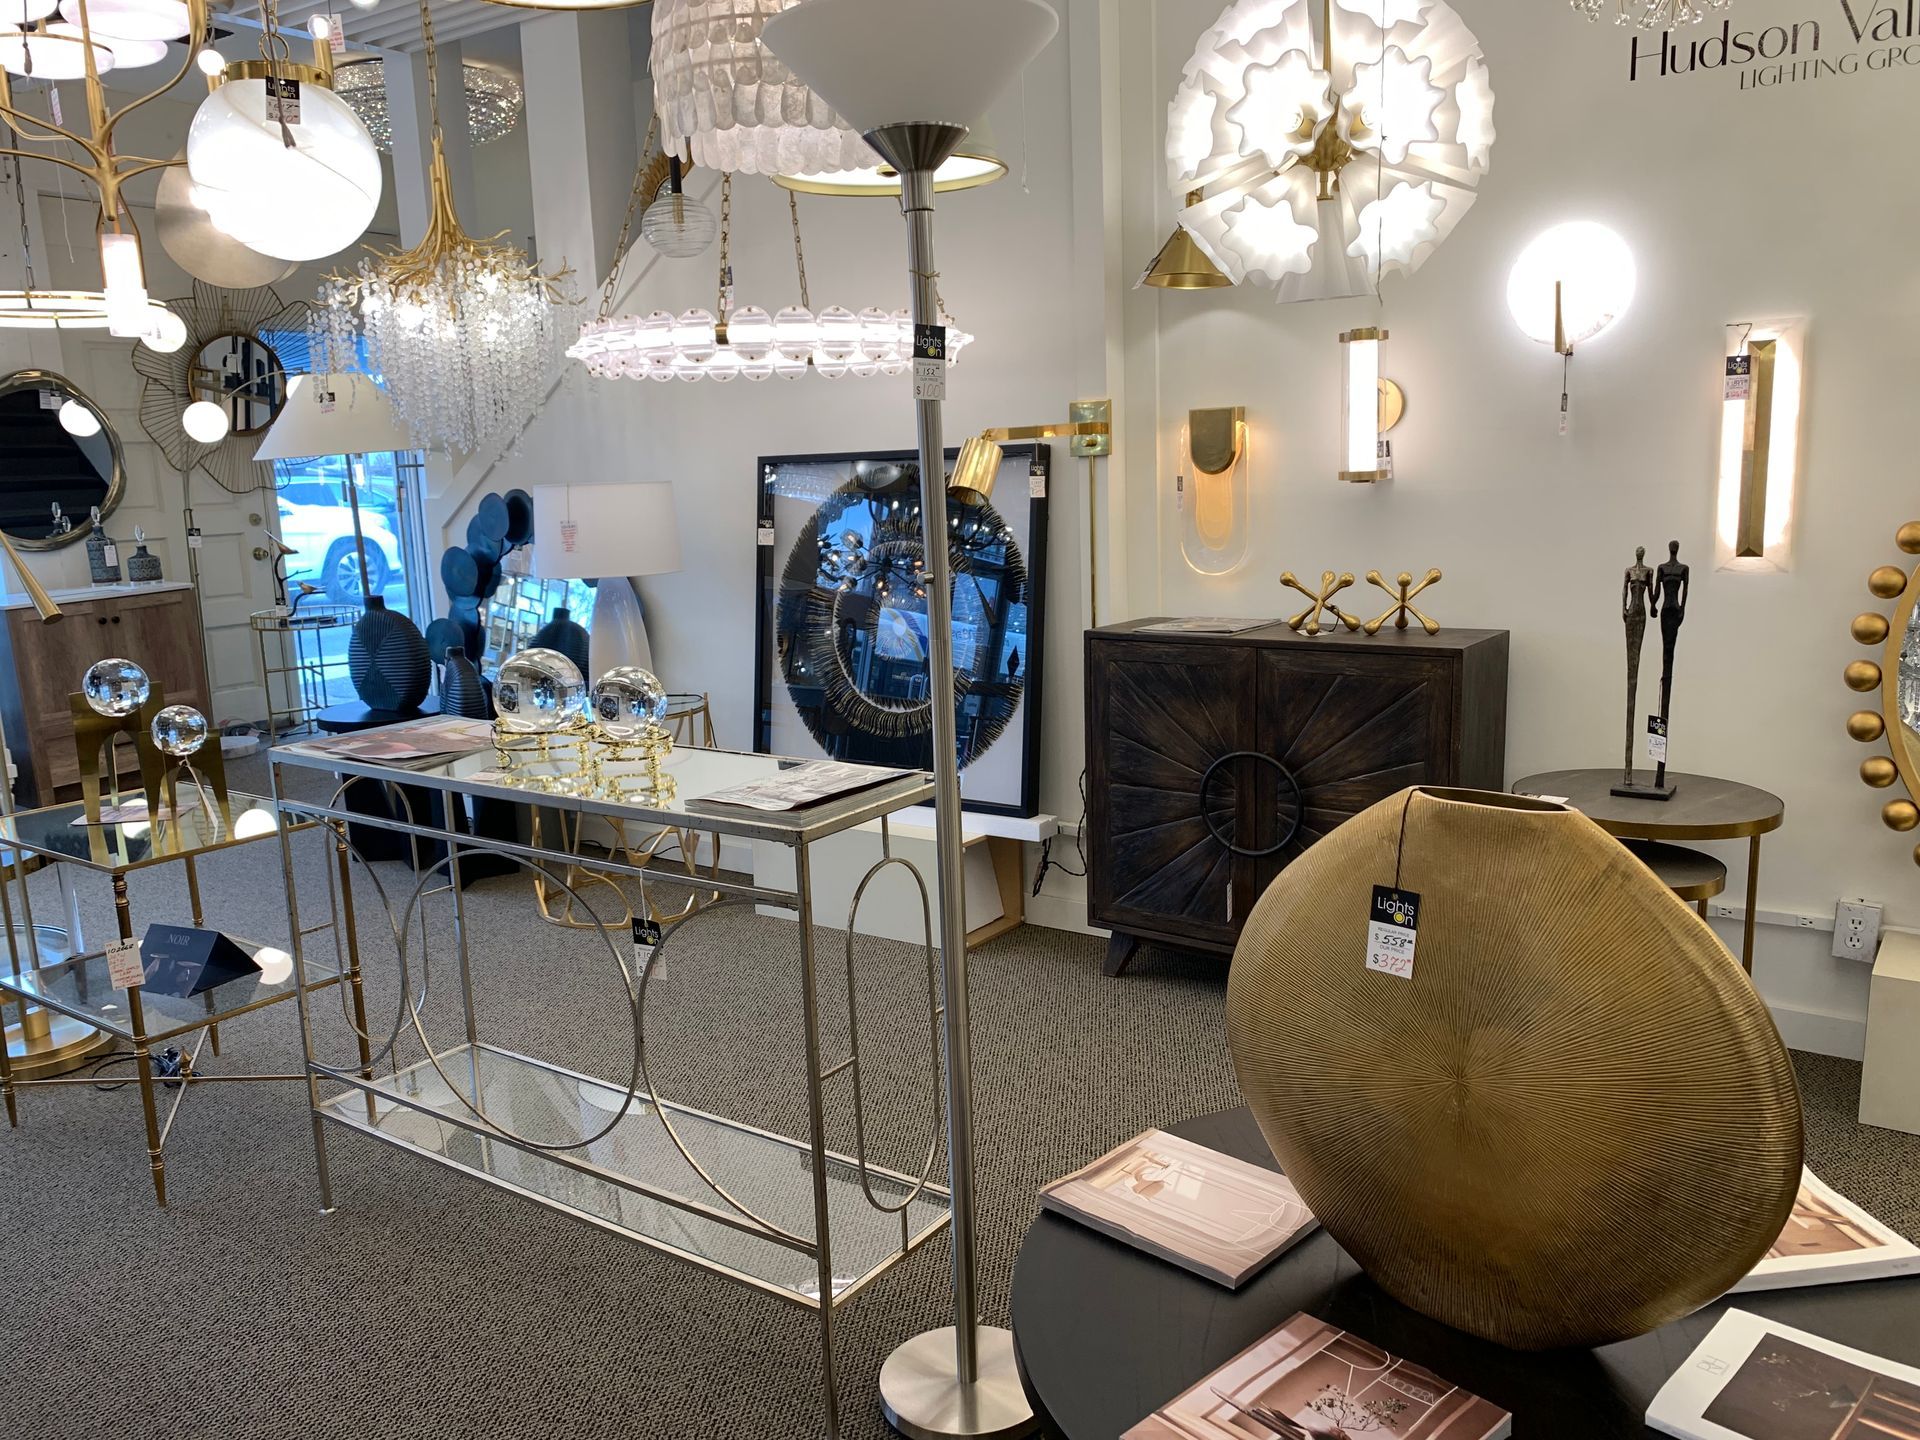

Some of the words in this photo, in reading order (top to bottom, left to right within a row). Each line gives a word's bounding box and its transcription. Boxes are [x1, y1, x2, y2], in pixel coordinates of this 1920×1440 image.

[1629, 20, 1820, 81] Hudson
[1740, 53, 1859, 90] LIGHTING
[916, 335, 942, 349] Lights
[927, 345, 942, 357] On
[1728, 361, 1748, 370] Lights
[1736, 366, 1748, 374] On
[1377, 896, 1415, 915] Lights
[1393, 911, 1414, 926] On
[634, 926, 659, 938] Lights
[1378, 926, 1397, 934] REGULAR
[1397, 930, 1410, 938] PRICE
[169, 933, 191, 946] NOIR
[646, 935, 660, 945] On
[1390, 946, 1405, 955] PRICE
[1382, 1373, 1440, 1404] MODERN
